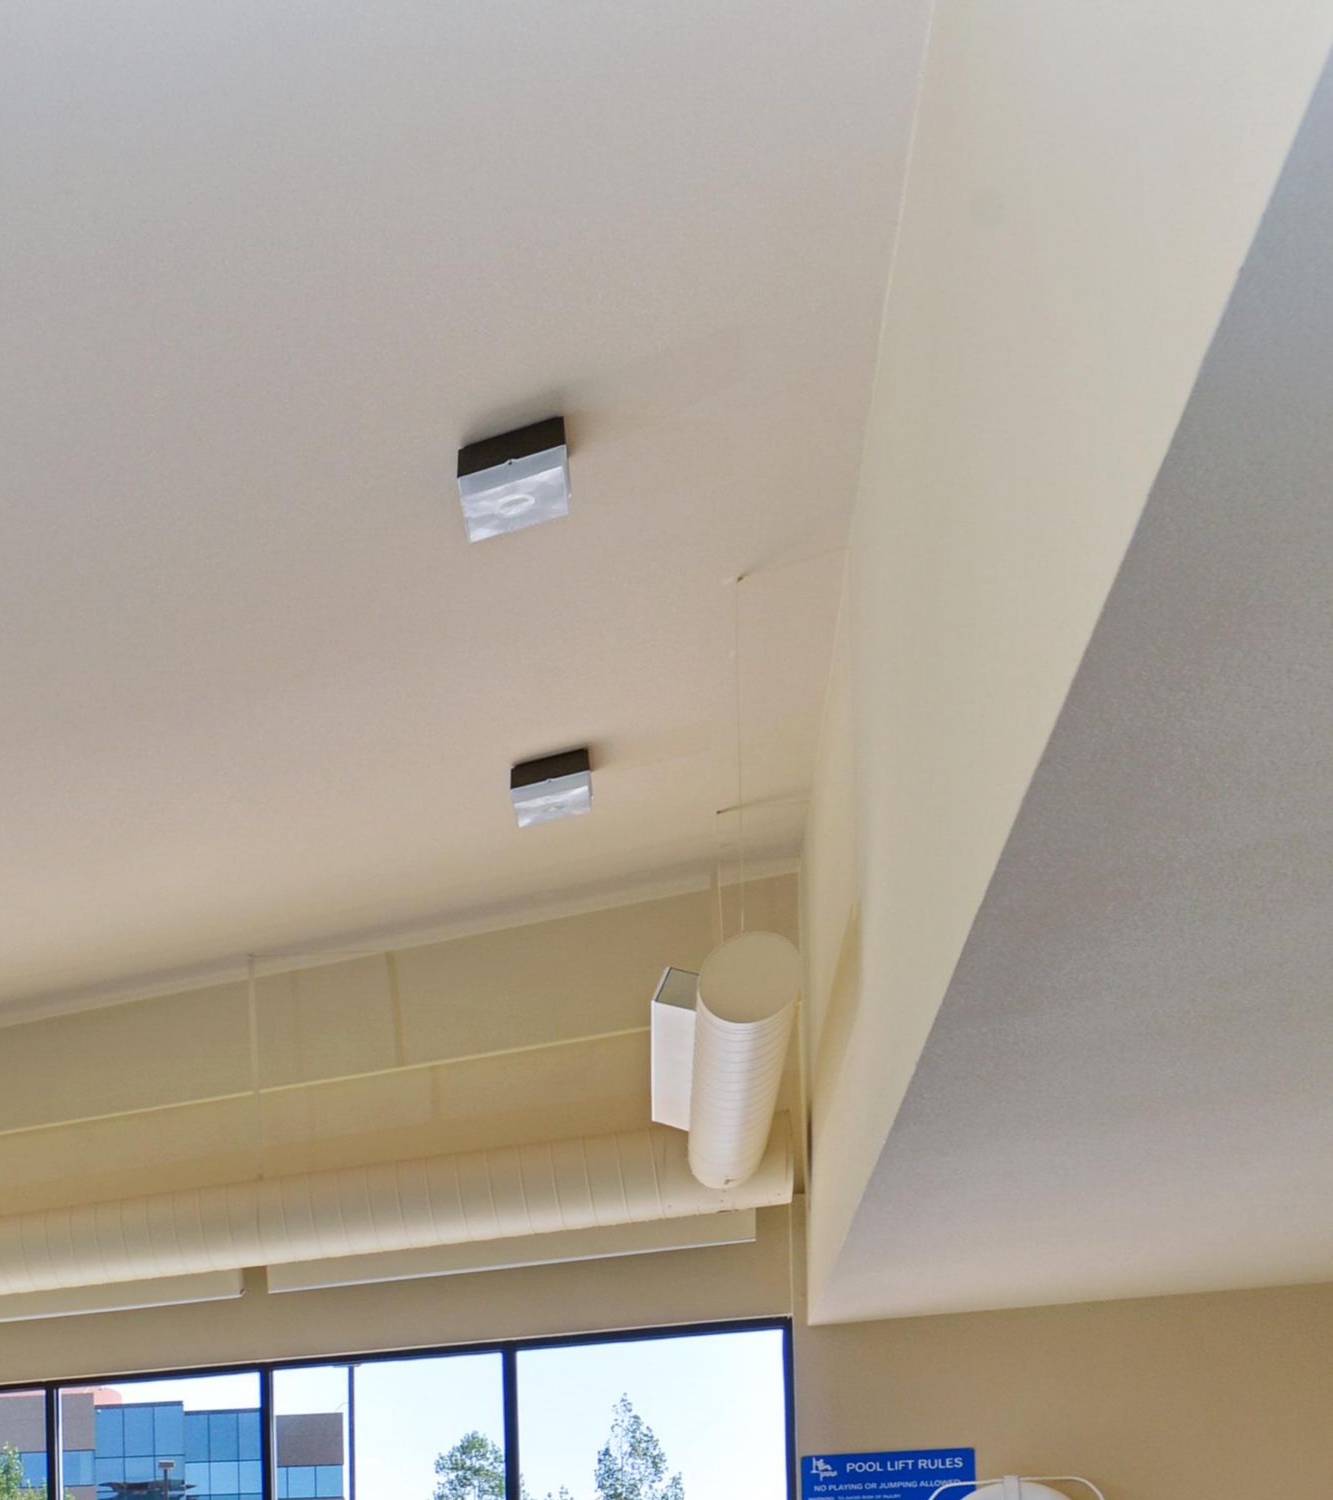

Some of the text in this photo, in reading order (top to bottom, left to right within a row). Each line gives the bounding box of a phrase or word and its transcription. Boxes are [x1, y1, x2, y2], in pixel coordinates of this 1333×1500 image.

[846, 1457, 964, 1473] POOL LIFT RULES
[813, 1484, 827, 1492] NO
[828, 1483, 864, 1492] PLAYING
[865, 1482, 879, 1490] OR
[879, 1480, 919, 1490] JUMPING
